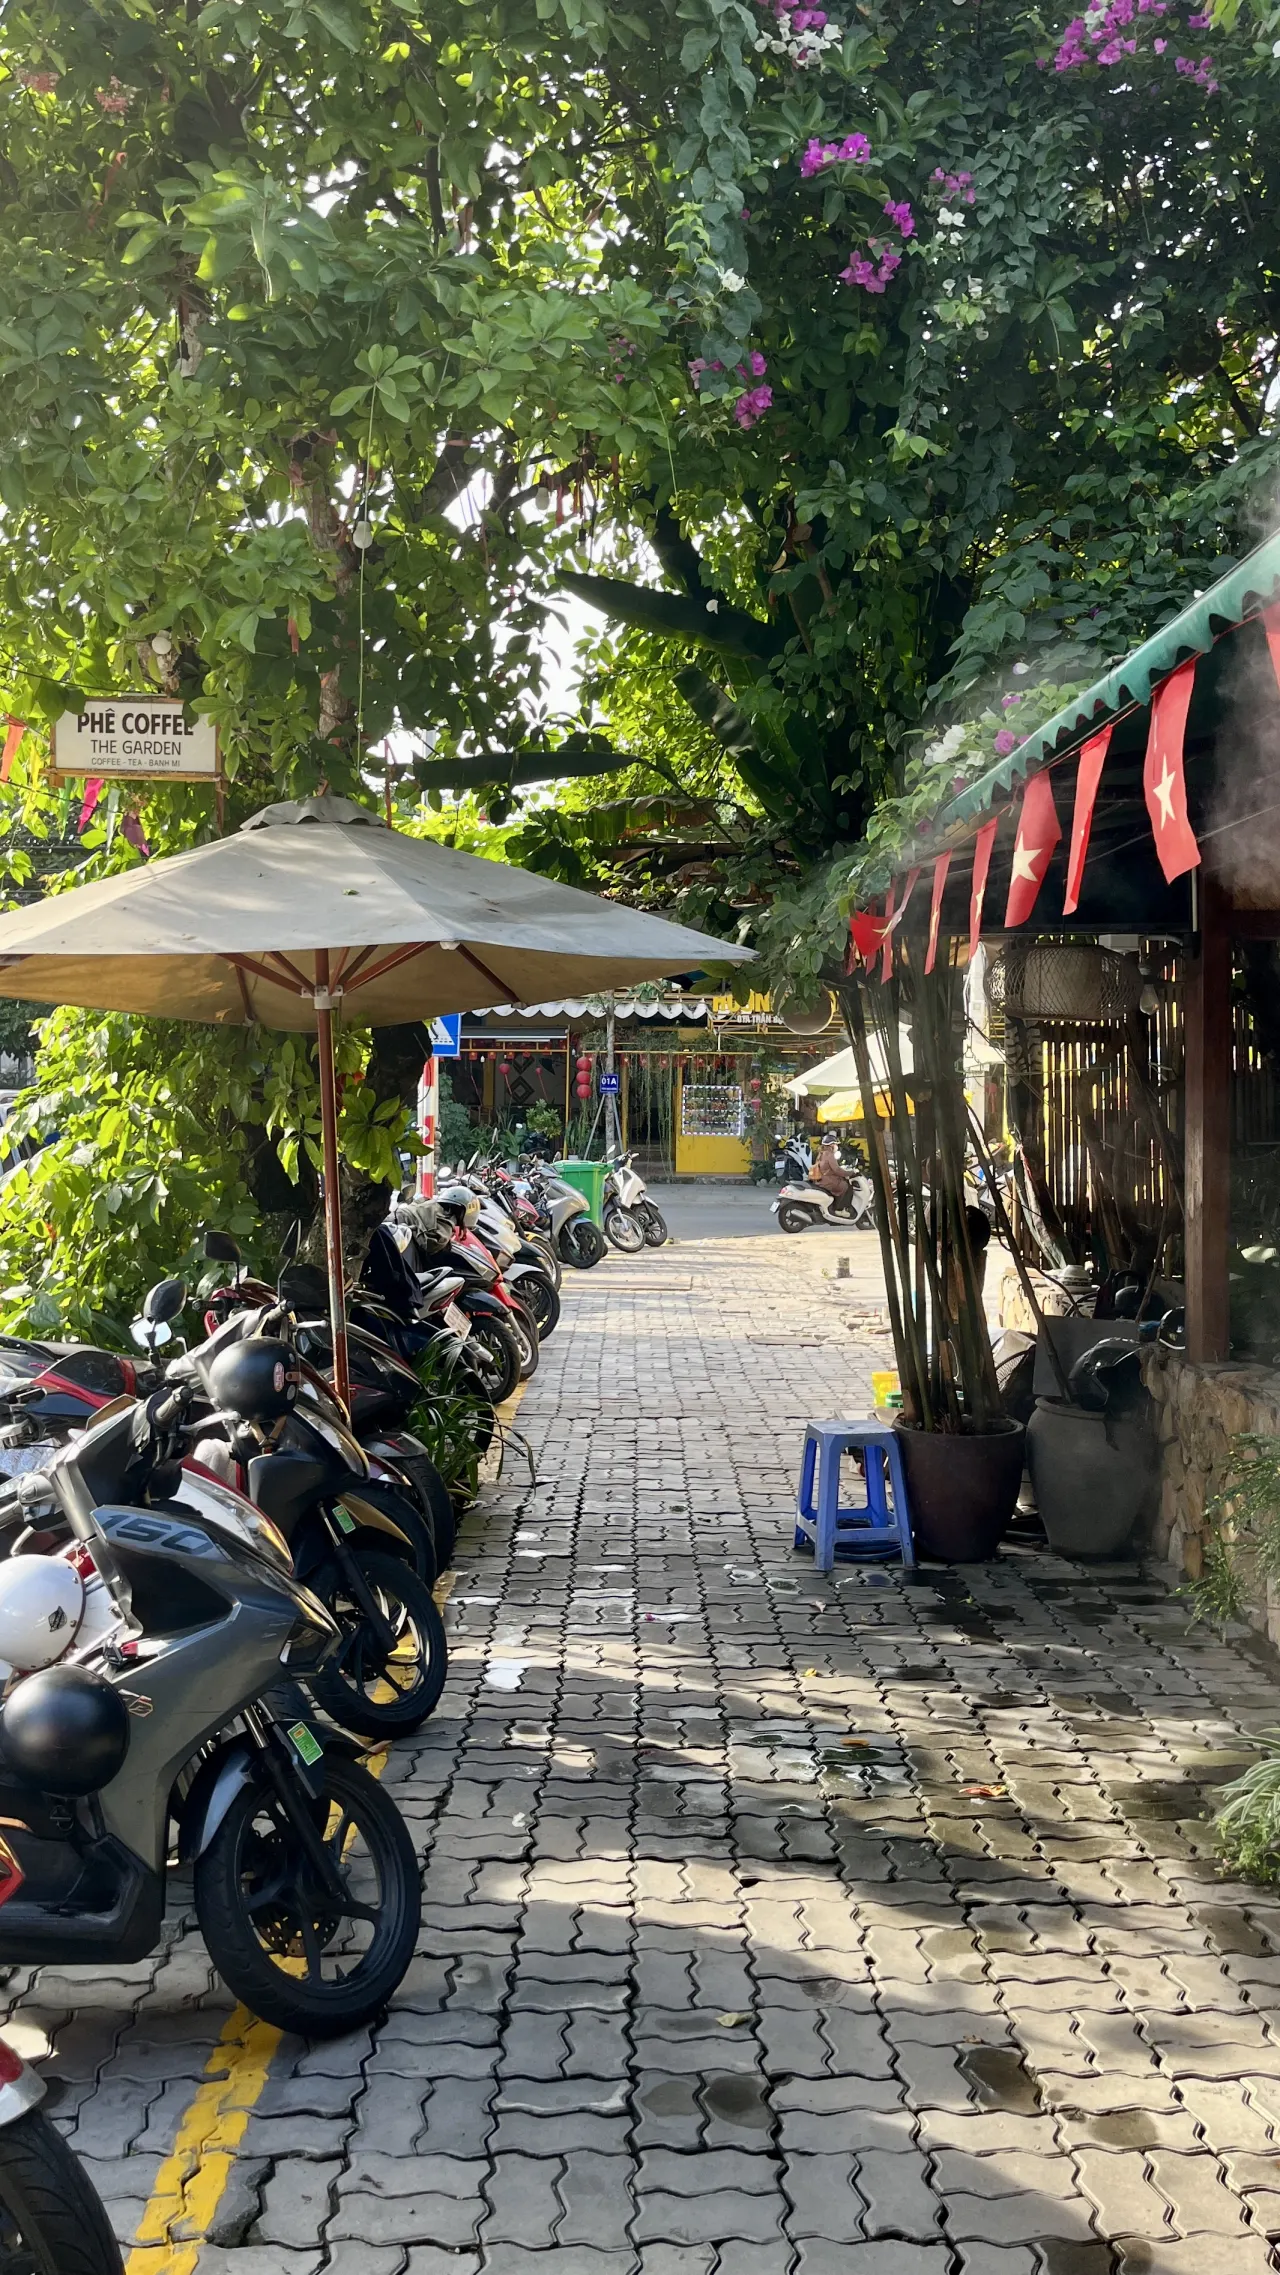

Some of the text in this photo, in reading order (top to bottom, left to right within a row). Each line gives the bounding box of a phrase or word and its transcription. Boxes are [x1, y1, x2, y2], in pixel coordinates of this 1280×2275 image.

[78, 708, 116, 734] PHÊ
[91, 739, 182, 756] THE GARDEN
[91, 757, 121, 766] COFFEE
[128, 758, 142, 767] TEA
[148, 759, 170, 767] BANH
[171, 759, 180, 767] MI
[601, 1077, 617, 1085] 01A
[101, 1514, 214, 1555] 150
